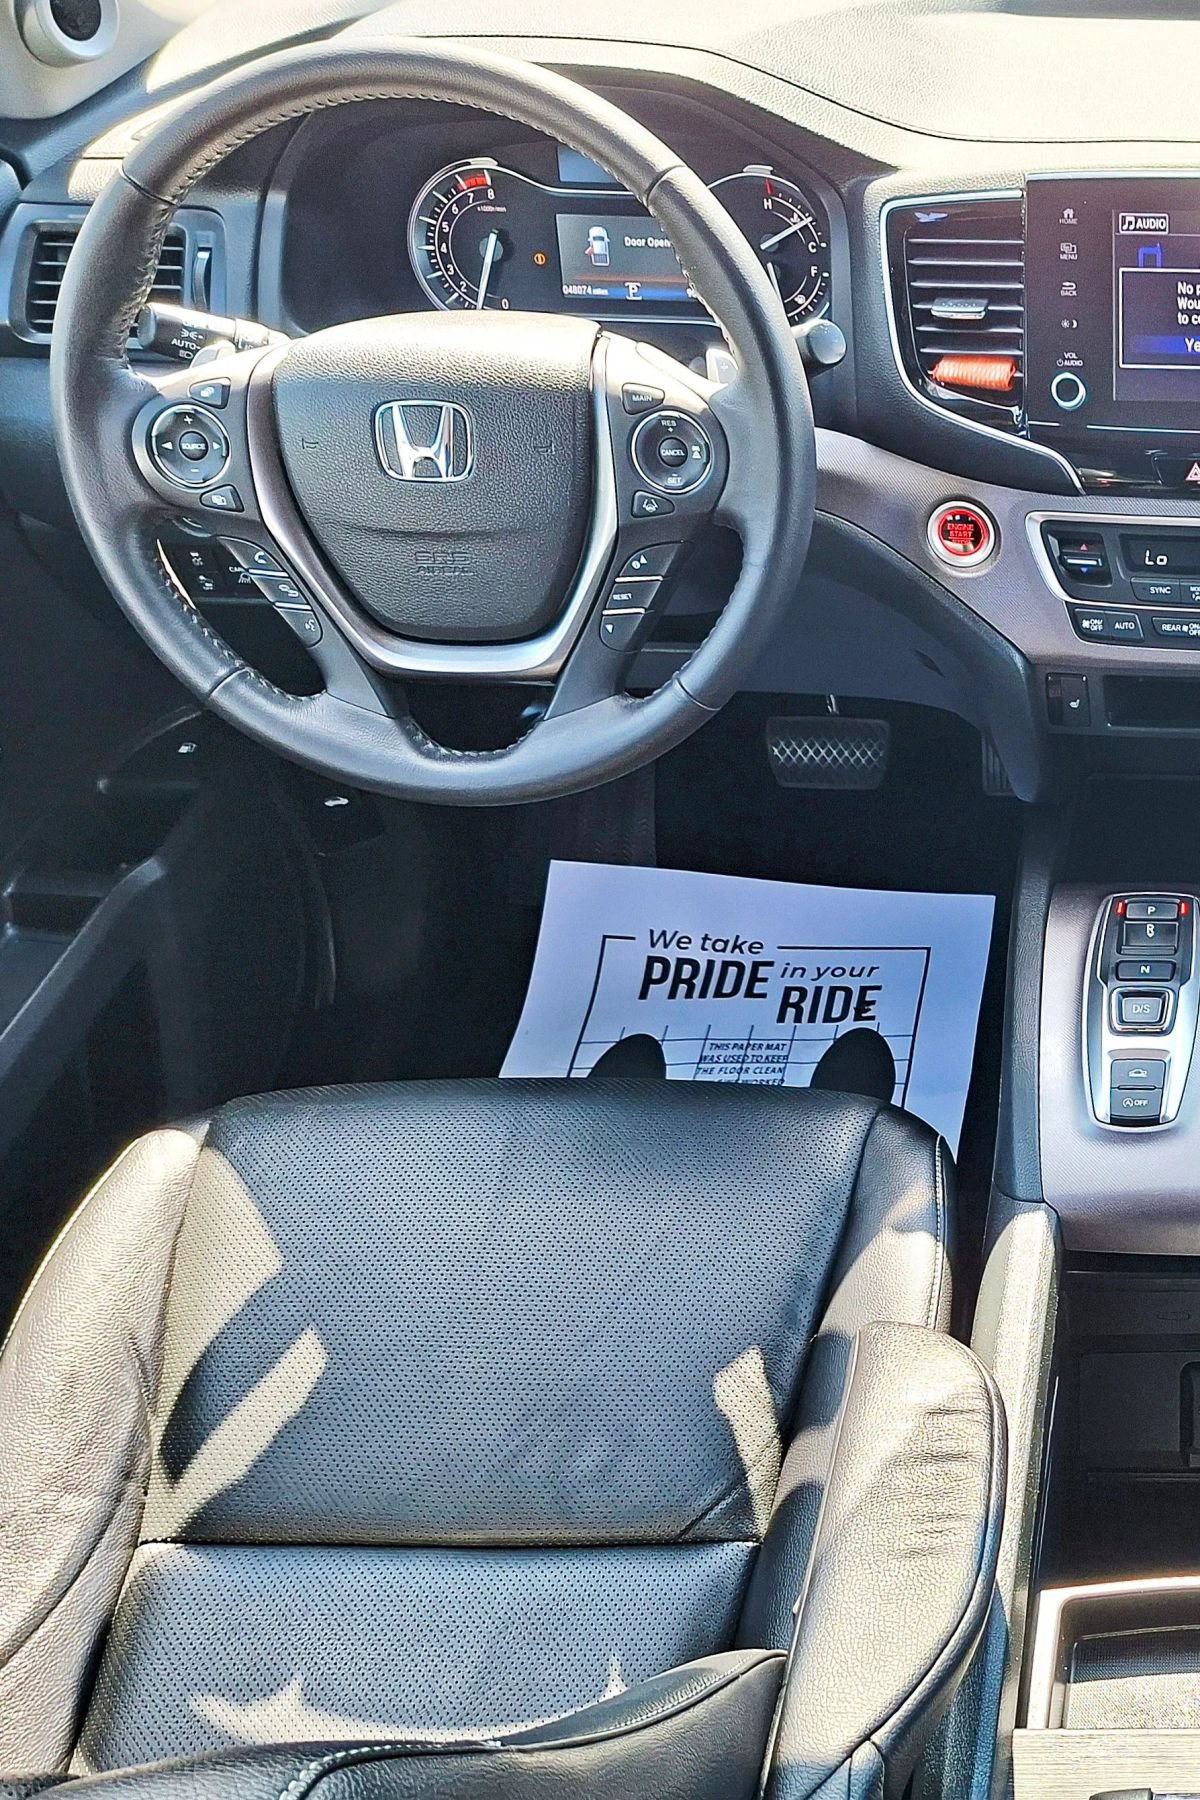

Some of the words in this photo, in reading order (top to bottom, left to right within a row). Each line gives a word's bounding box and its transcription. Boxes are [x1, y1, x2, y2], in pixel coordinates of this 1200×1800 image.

[467, 193, 475, 203] 7
[487, 189, 495, 200] 8
[452, 203, 459, 214] 6
[763, 199, 773, 210] H
[441, 221, 450, 232] 5
[1136, 218, 1167, 230] AUDIO
[624, 236, 646, 247] Door
[647, 237, 671, 248] Open
[808, 242, 817, 253] C
[440, 242, 448, 254] 4
[447, 264, 455, 275] 3
[810, 266, 818, 277] F
[459, 281, 467, 292] 2
[1177, 282, 1193, 294] No
[502, 298, 509, 310] 0
[1177, 313, 1189, 325] to
[171, 338, 196, 350] AUTO
[1064, 359, 1083, 367] AUDIO
[632, 394, 652, 402] MAIN
[181, 442, 206, 450] SOURCE
[661, 449, 685, 457] CANCEL
[667, 477, 682, 485] SET
[947, 523, 975, 531] ENGINE
[1145, 549, 1168, 566] Lo
[1150, 586, 1171, 594] SYNC
[1114, 622, 1135, 630] AUTO
[1147, 906, 1156, 915] P
[649, 928, 692, 951] We
[700, 933, 764, 955] take
[1140, 965, 1150, 974] N
[638, 955, 775, 1001] PRIDE
[780, 962, 807, 979] in
[810, 966, 880, 982] your
[776, 985, 882, 1024] RIDE
[1132, 1004, 1150, 1014] D/S
[709, 1042, 731, 1051] THIS
[732, 1042, 764, 1051] PAPER
[765, 1043, 787, 1052] MAT
[702, 1054, 722, 1063] WAS
[723, 1054, 750, 1063] USED
[751, 1054, 764, 1063] TO
[764, 1054, 788, 1063] KEEP
[697, 1067, 715, 1075] THE
[717, 1067, 750, 1075] FLOOR
[753, 1067, 784, 1075] CLEAN
